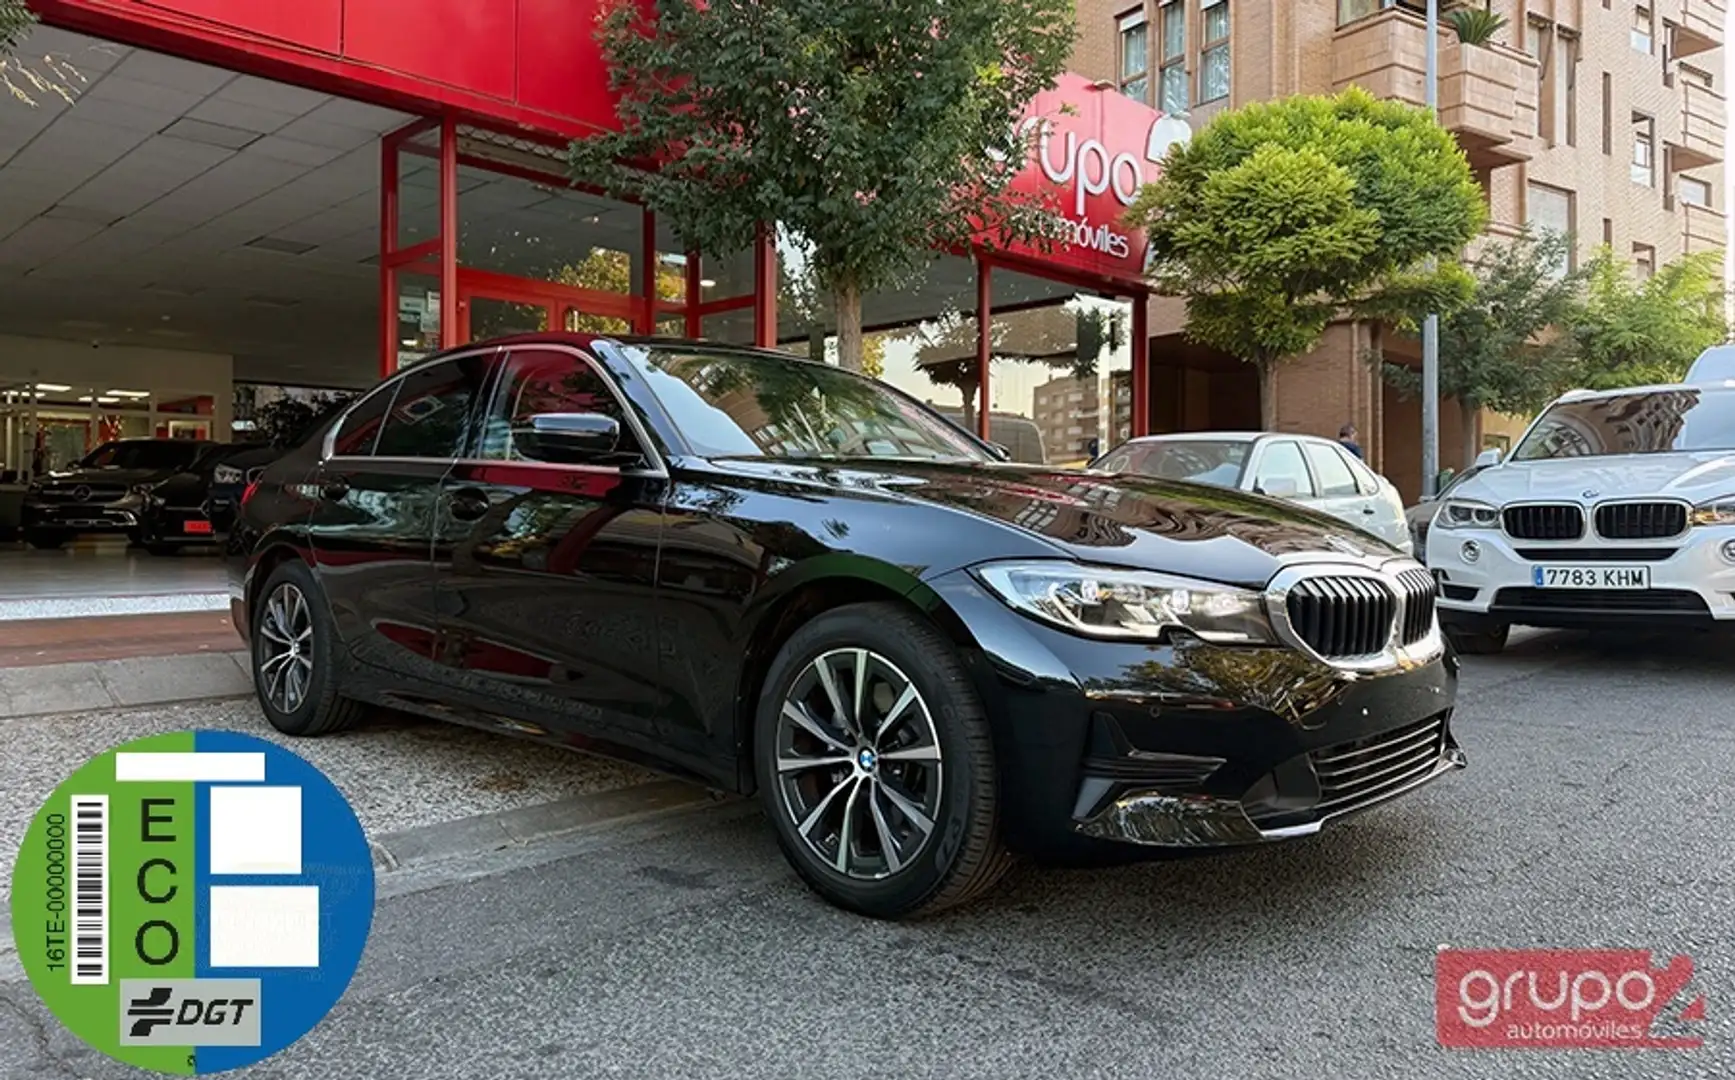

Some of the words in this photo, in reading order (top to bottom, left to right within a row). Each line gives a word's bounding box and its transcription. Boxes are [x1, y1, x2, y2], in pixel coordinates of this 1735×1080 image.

[1015, 209, 1129, 258] móviles
[1546, 568, 1597, 586] 7783
[1603, 569, 1644, 586] KHM
